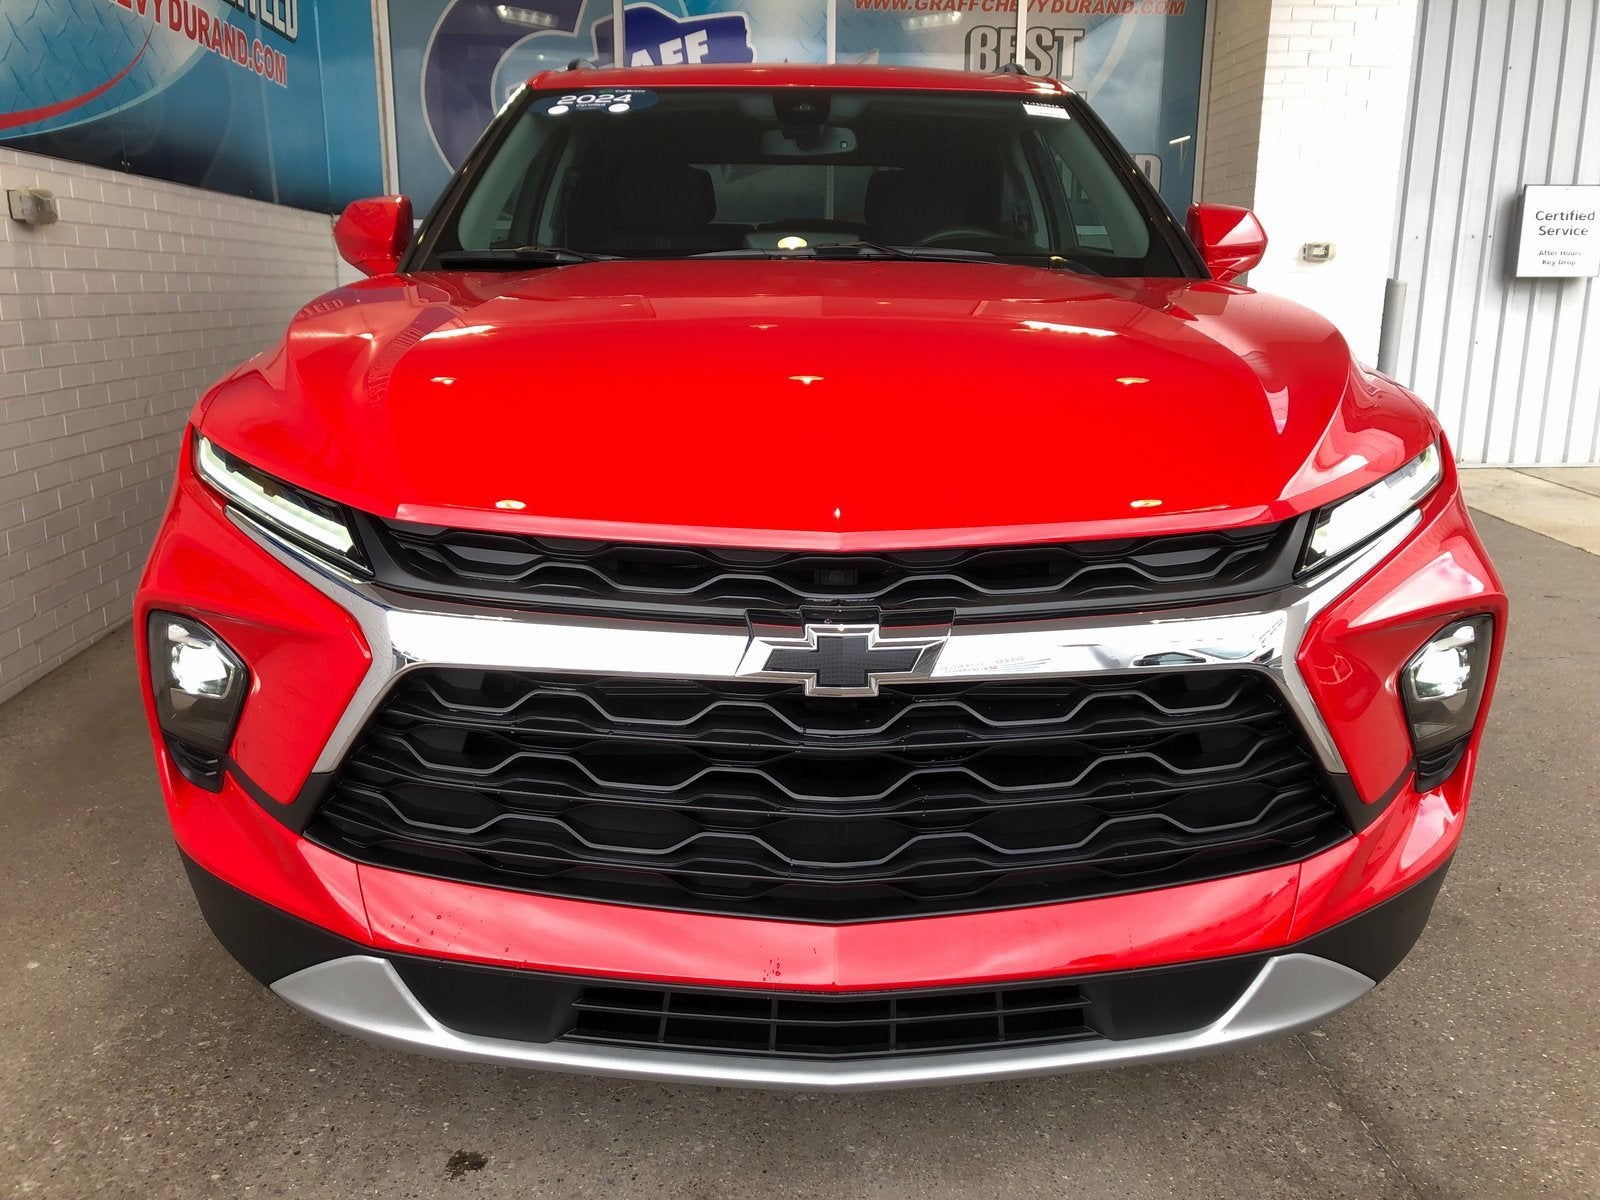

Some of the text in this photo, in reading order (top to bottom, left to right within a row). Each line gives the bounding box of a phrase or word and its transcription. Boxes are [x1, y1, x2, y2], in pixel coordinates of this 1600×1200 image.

[965, 25, 1086, 79] BEST
[556, 93, 632, 106] 2024
[1535, 210, 1596, 221] Certified
[1538, 225, 1589, 236] Service
